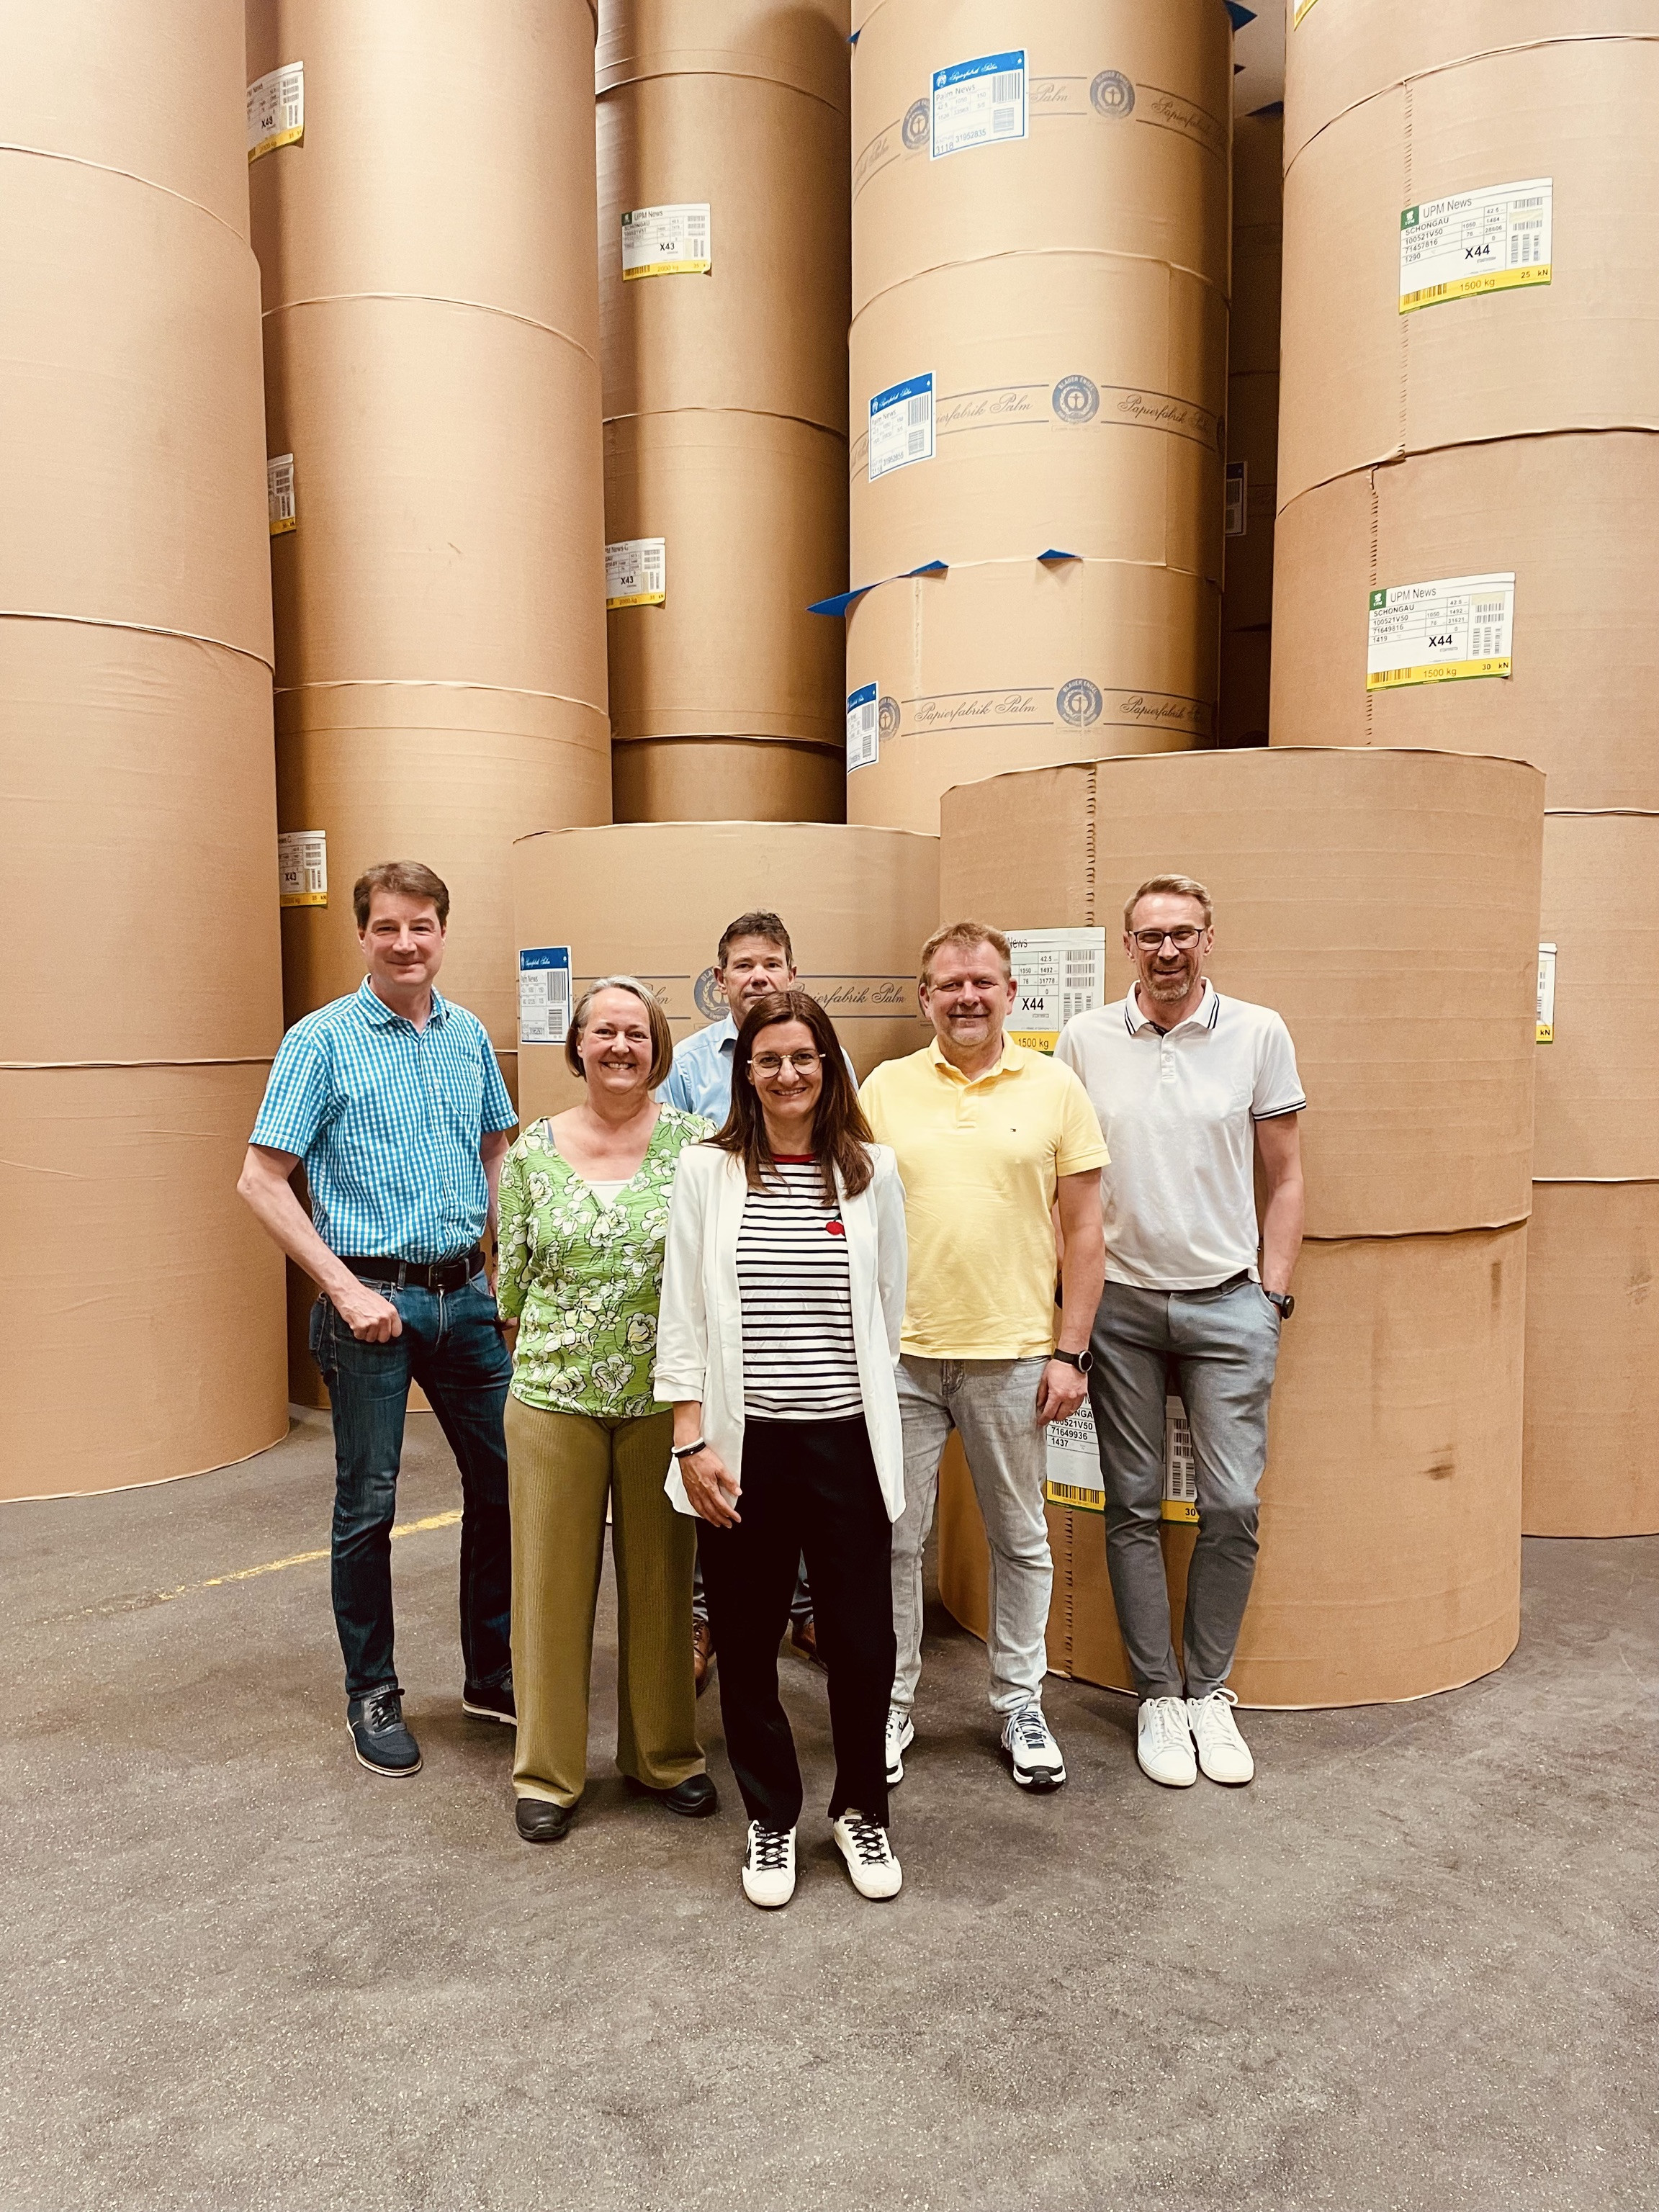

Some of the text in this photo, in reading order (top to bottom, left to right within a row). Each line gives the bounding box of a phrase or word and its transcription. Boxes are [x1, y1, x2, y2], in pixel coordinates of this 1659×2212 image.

[936, 84, 976, 102] Palm News
[1030, 83, 1068, 105] Palm
[956, 128, 986, 143] 31952835
[936, 142, 953, 155] 3118
[1423, 198, 1472, 218] UPM News
[634, 211, 647, 221] UPM
[1406, 217, 1449, 236] SCHONGAU
[1405, 229, 1443, 246] 100521V50
[660, 242, 675, 251] X43
[1405, 239, 1439, 254] 71457816
[1465, 244, 1490, 259] X44
[1405, 253, 1421, 264] 1290
[1460, 278, 1495, 292] 1500 kg
[934, 392, 1033, 425] ierfabrik Palm
[1118, 393, 1187, 423] Papierfabrik
[621, 575, 634, 585] X43
[1390, 588, 1437, 603] UPM News
[1373, 603, 1415, 617] SCHONGAU
[1373, 614, 1408, 626] 100521V50
[1373, 624, 1404, 634] 71649816
[1428, 634, 1453, 647] X44
[1424, 667, 1457, 678] 1500 kg
[914, 695, 1038, 723] Papierfabrik Palm
[1120, 695, 1184, 720] Papierfabrik
[284, 871, 297, 881] X43
[793, 981, 907, 1009] ierfabrik Palm
[1022, 997, 1044, 1011] X44
[1018, 1038, 1049, 1050] 1500 kg
[1051, 1427, 1088, 1440] 71649936
[1051, 1437, 1069, 1447] 1437
[1184, 1508, 1196, 1516] 30
